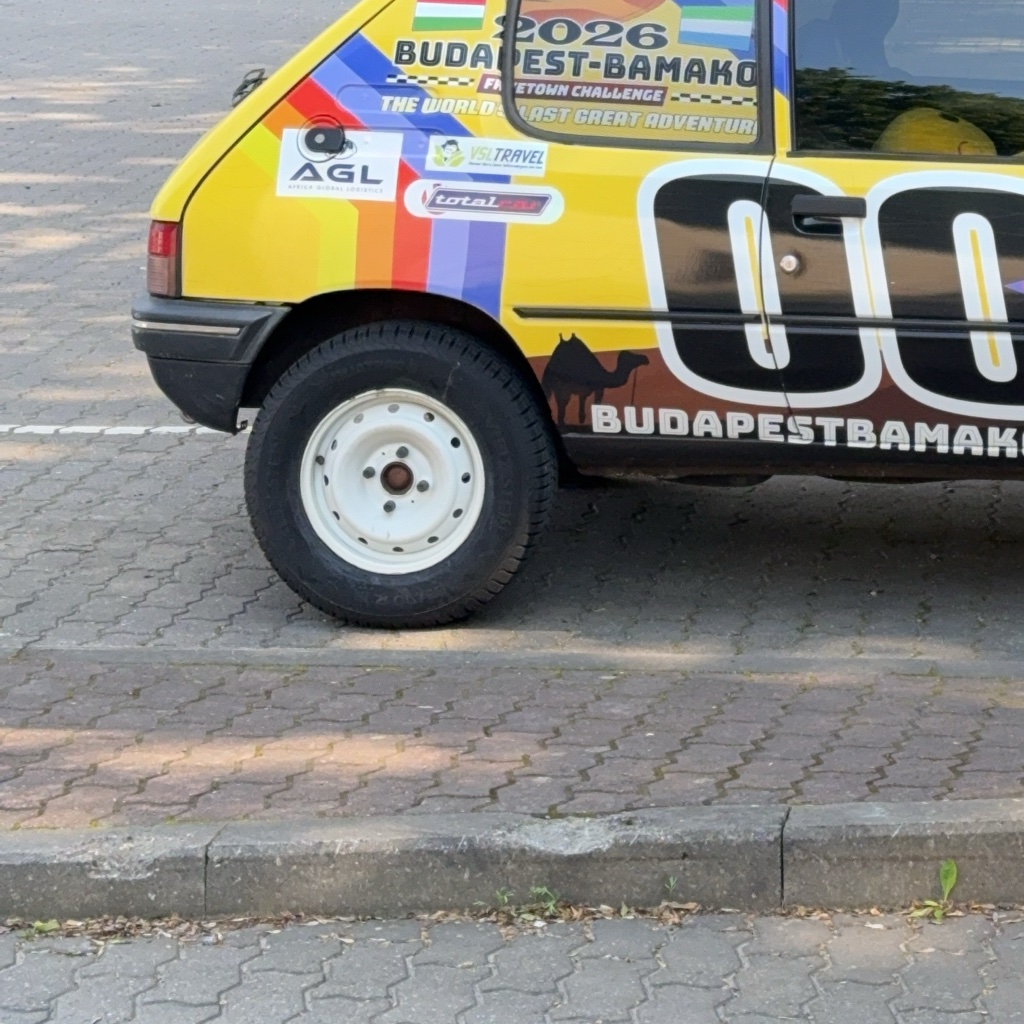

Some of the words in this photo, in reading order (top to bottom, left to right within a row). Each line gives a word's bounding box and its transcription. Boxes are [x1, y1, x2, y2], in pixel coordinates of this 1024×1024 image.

[491, 15, 669, 51] 2026
[483, 77, 568, 97] FRETOWN
[571, 84, 664, 102] CHALLENGE
[381, 95, 420, 114] THE
[518, 104, 572, 124] LAST
[573, 107, 642, 128] GREAT
[289, 162, 383, 185] AGL
